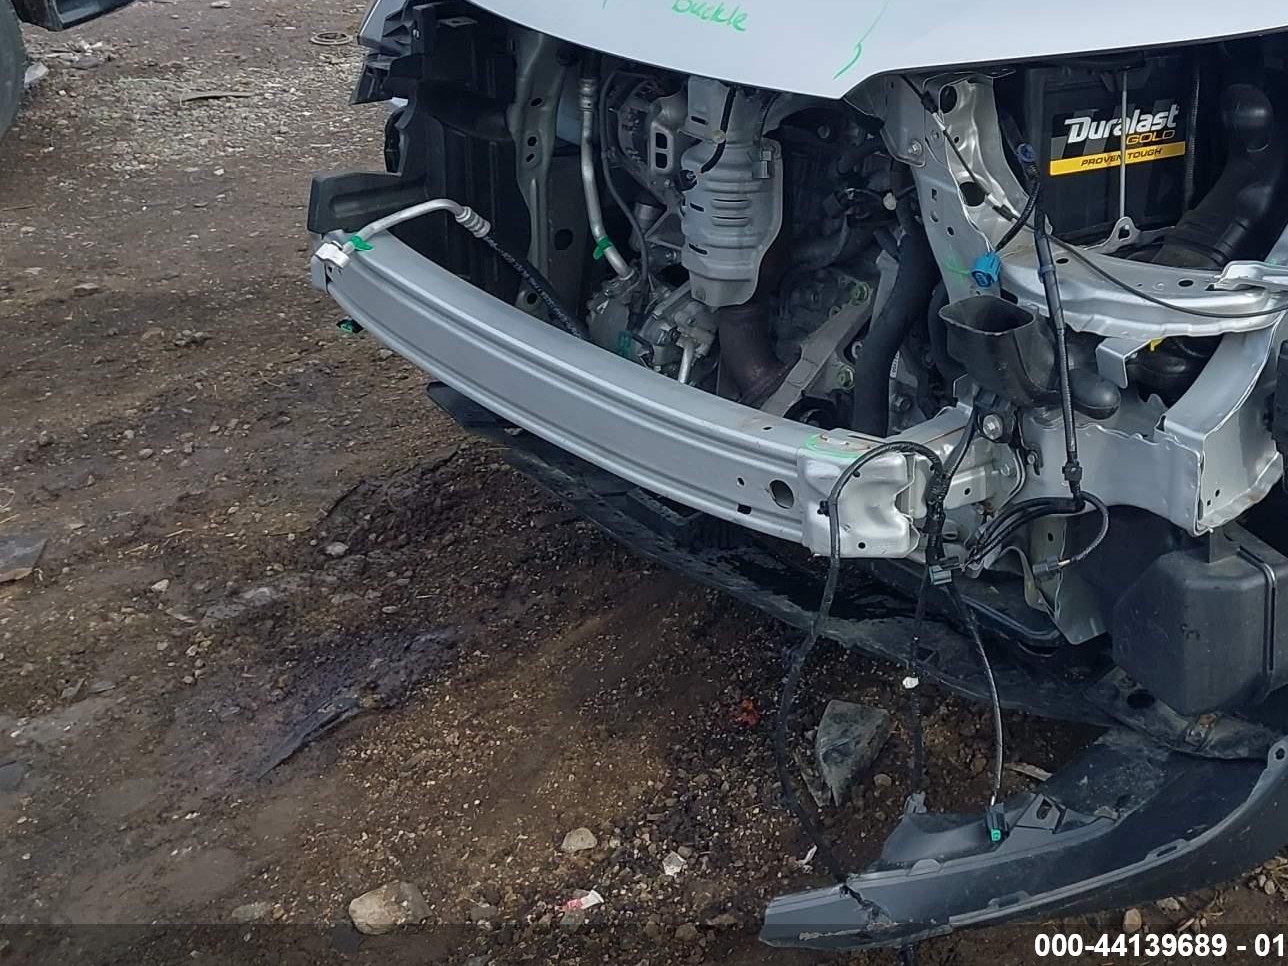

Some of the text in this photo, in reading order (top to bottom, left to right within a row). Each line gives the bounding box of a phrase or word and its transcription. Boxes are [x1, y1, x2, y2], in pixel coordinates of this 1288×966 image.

[1064, 103, 1180, 144] Duralast
[1126, 129, 1176, 146] GOLD
[1081, 147, 1163, 167] PROVEN TOUGH
